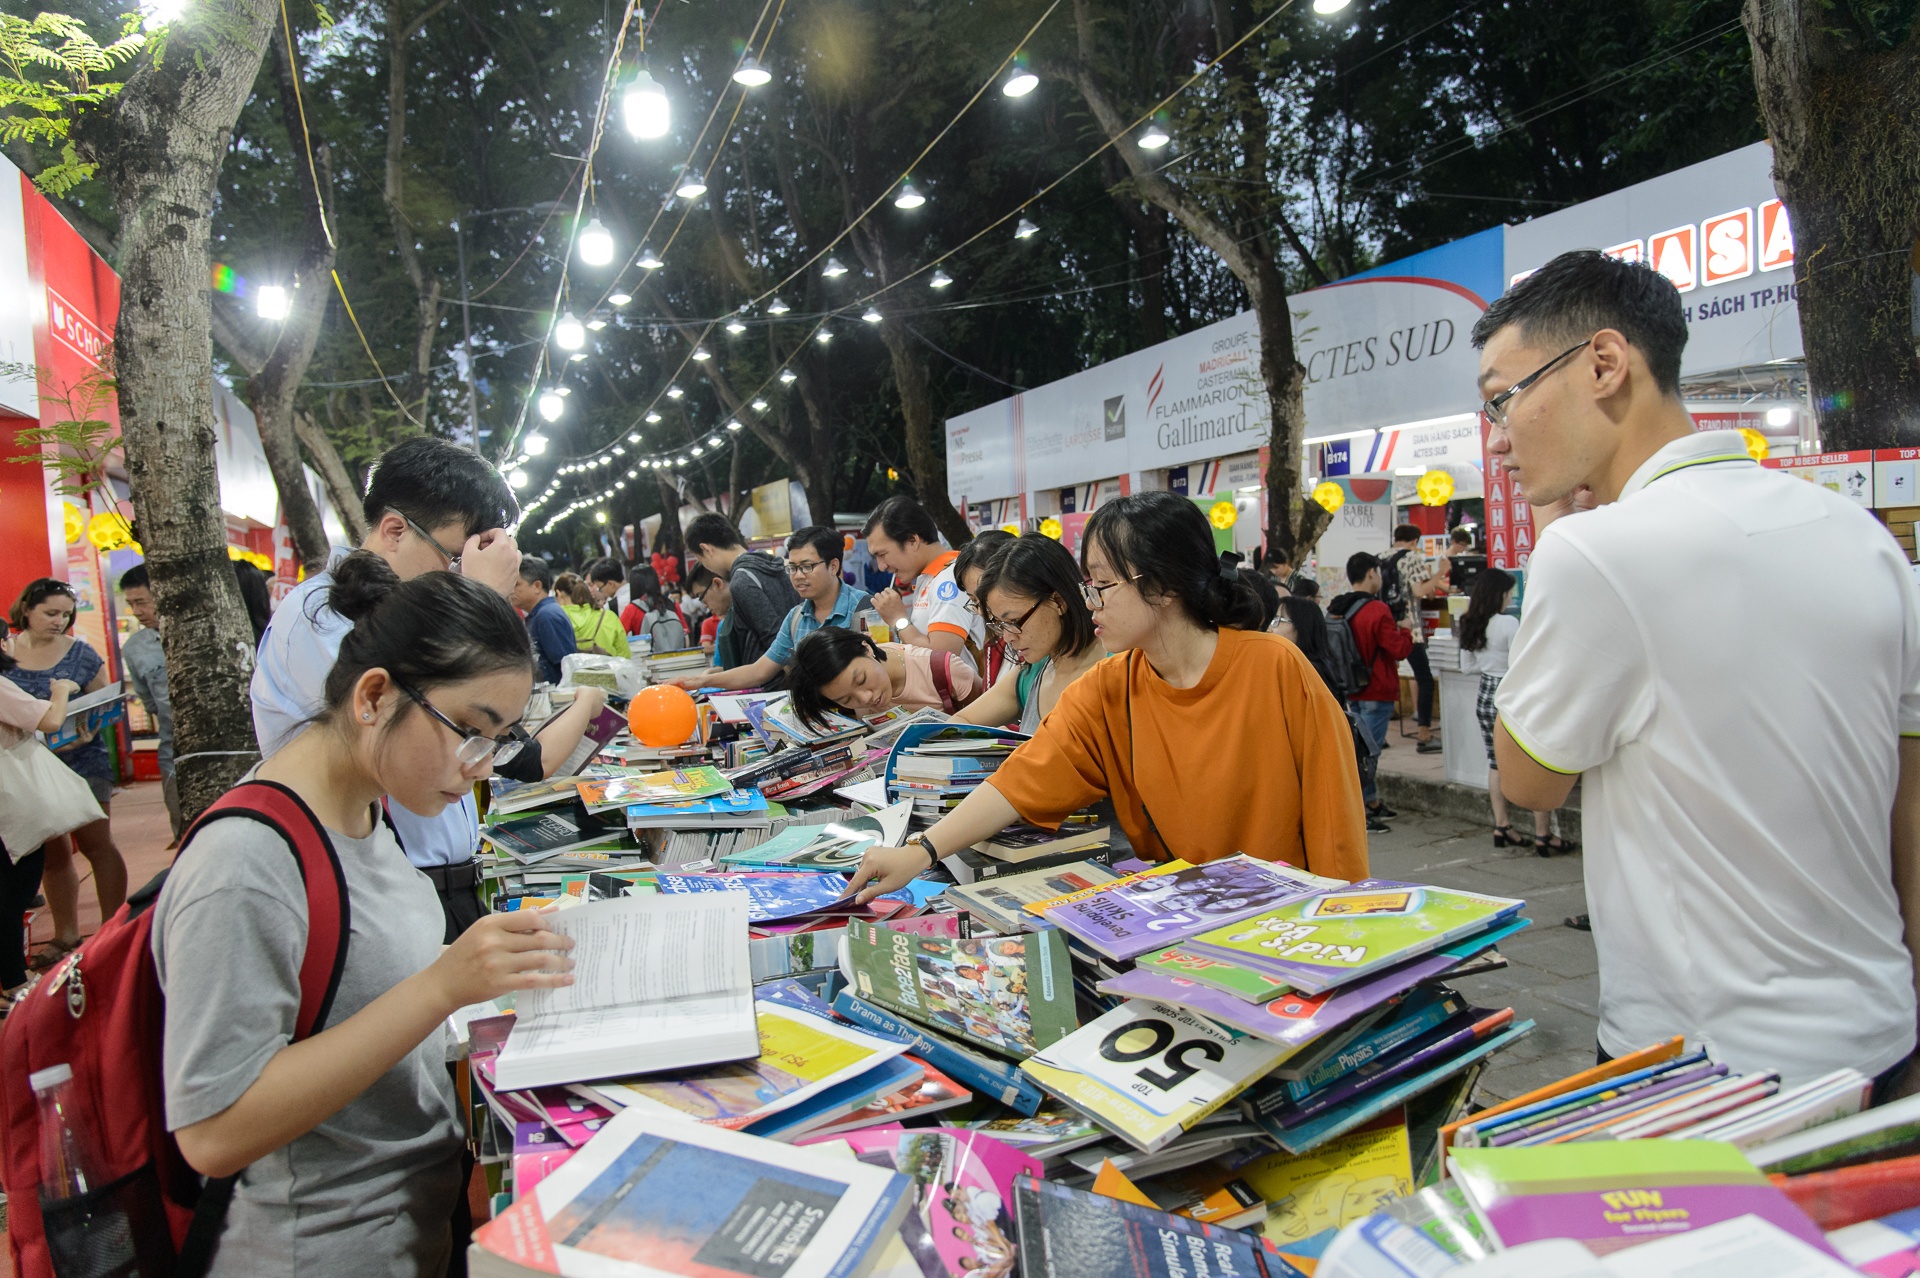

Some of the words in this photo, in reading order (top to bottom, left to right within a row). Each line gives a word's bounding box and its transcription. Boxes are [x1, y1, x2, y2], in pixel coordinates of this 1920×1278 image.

[1697, 294, 1746, 321] SÁCH
[66, 313, 106, 361] SCHO
[1211, 331, 1249, 353] GROUPE
[1199, 349, 1249, 374] MADRIGALL
[1305, 336, 1377, 384] CTES
[1385, 317, 1455, 367] SUD
[1155, 382, 1248, 420] FLAMMARION
[1157, 403, 1247, 451] Gallimard
[1327, 451, 1348, 465] B174
[1780, 457, 1794, 468] TOP
[1802, 455, 1820, 466] BEST
[1821, 453, 1849, 464] SELLER
[1899, 448, 1915, 459] TOP
[1172, 477, 1187, 489] B173
[1343, 504, 1375, 517] BABEL
[1343, 516, 1375, 529] NOIR
[980, 760, 995, 769] Data
[1091, 896, 1135, 922] Skills
[1072, 903, 1132, 939] Developing
[1146, 913, 1193, 931] 2
[1255, 917, 1321, 942] Box
[1259, 936, 1367, 963] Kid's
[891, 934, 920, 1010] face2face
[850, 999, 882, 1026] Drama
[883, 1019, 896, 1032] as
[1152, 1003, 1180, 1020] SCORE
[1177, 1013, 1197, 1029] TOP
[850, 1024, 879, 1038] EDITION
[780, 1053, 811, 1069] CS4
[1099, 1018, 1225, 1093] 50
[1308, 1061, 1341, 1087] College
[1337, 1044, 1374, 1071] Physics
[1131, 1082, 1153, 1097] TOP
[1266, 1151, 1318, 1171] Listening
[1320, 1144, 1342, 1158] and
[1600, 1189, 1663, 1210] FUN
